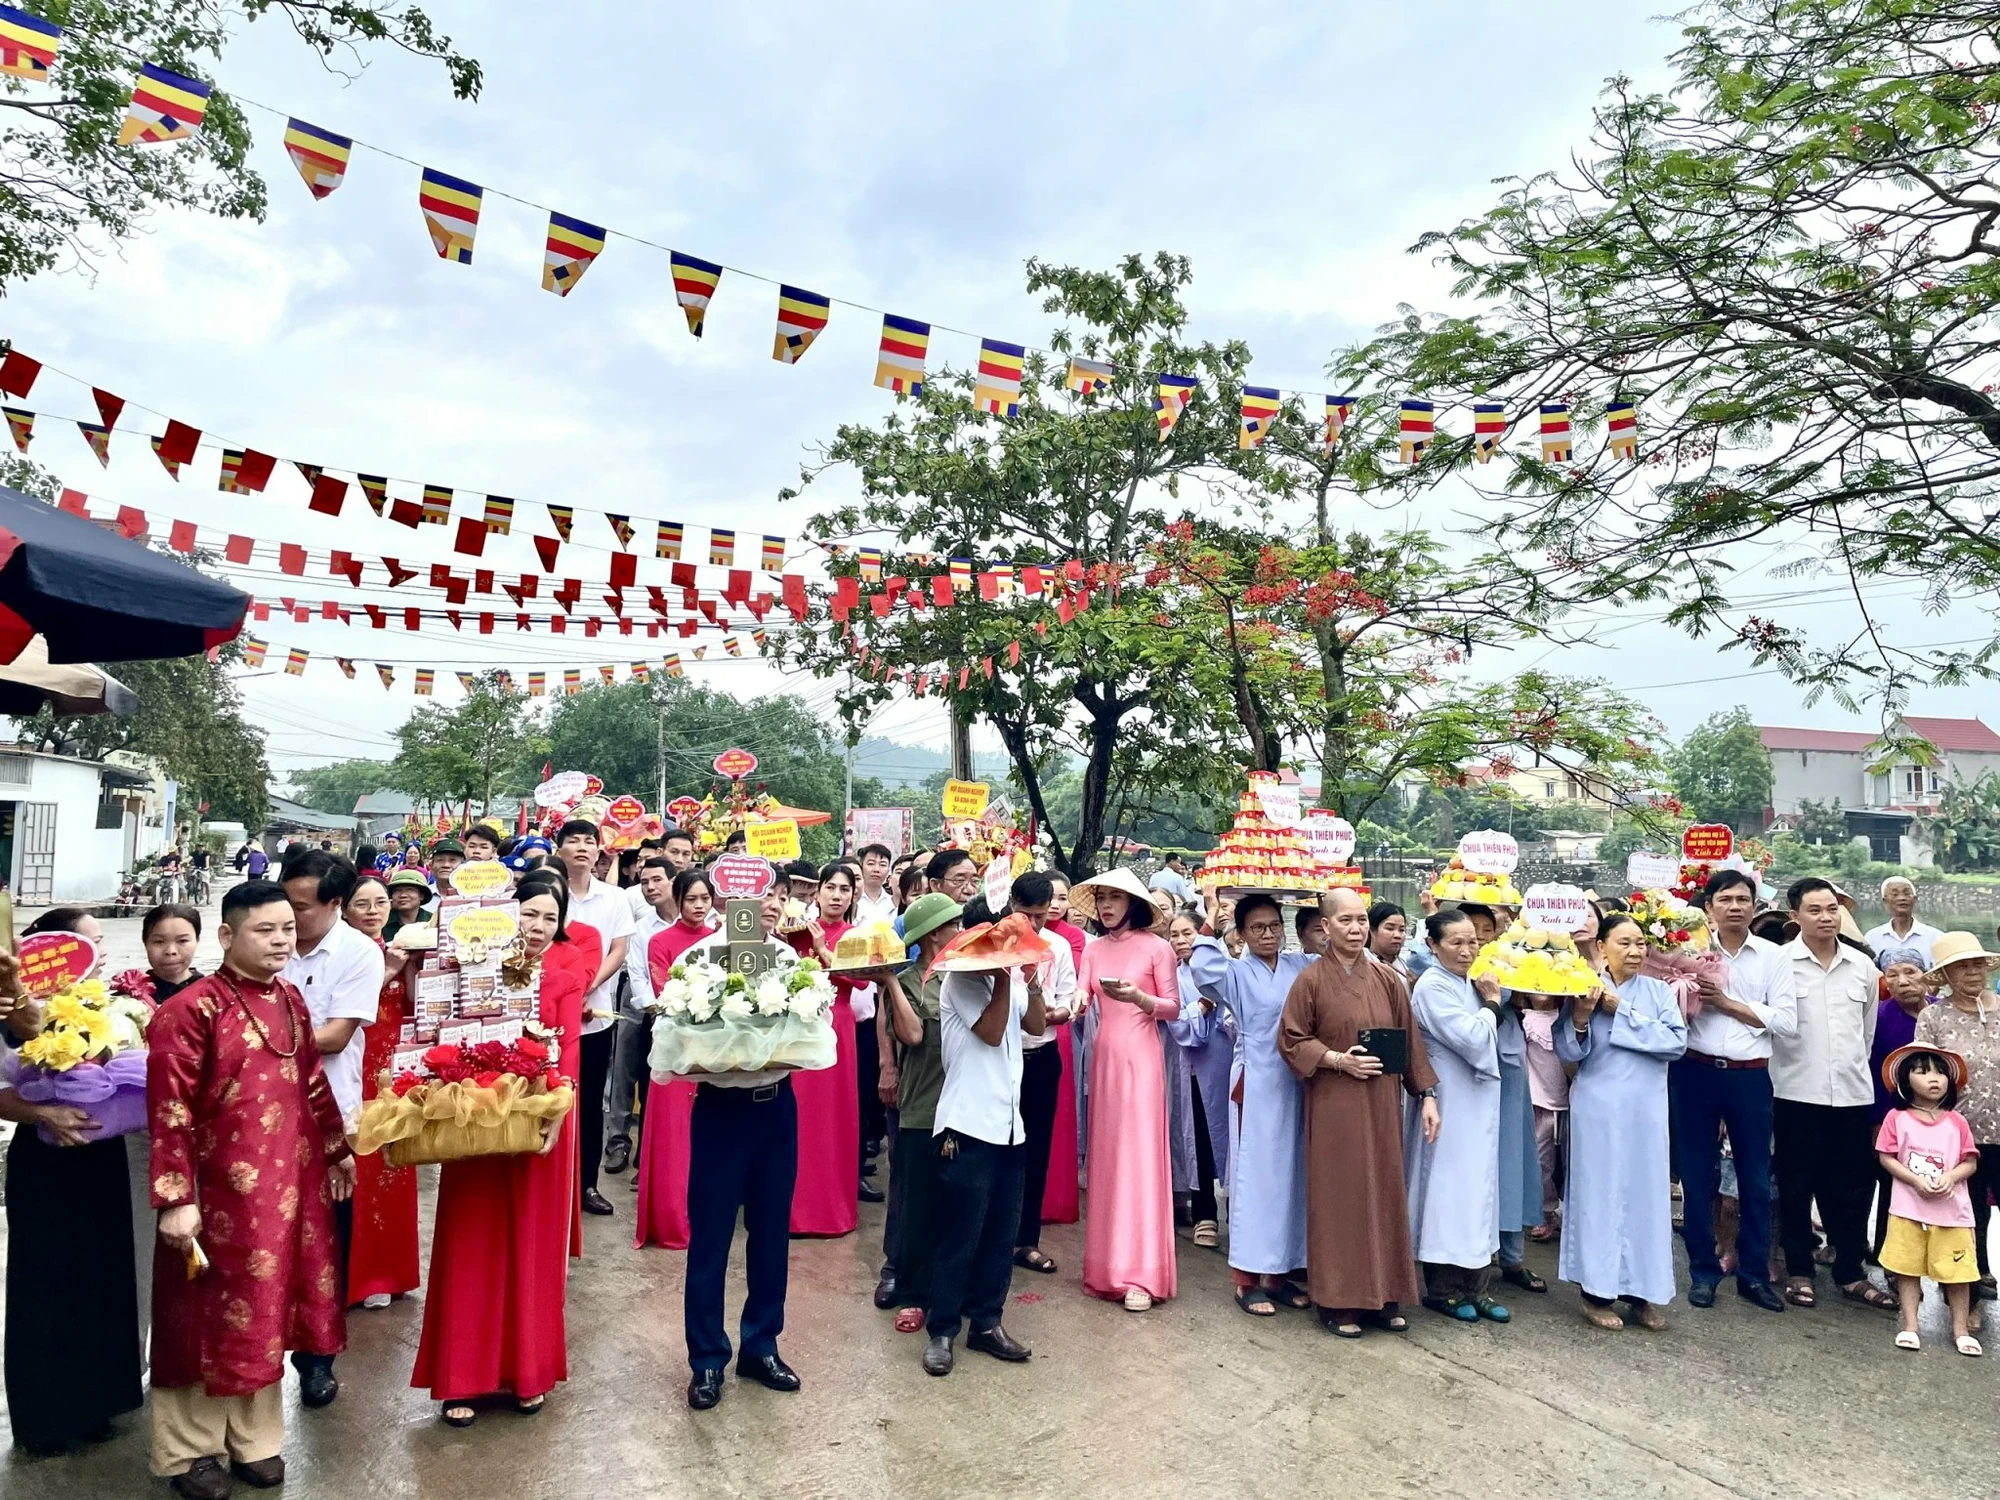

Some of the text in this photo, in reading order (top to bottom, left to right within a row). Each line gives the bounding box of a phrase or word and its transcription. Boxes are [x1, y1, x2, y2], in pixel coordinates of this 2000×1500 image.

[964, 827, 973, 842] AFC
[1336, 827, 1352, 841] PHÚC
[1463, 842, 1481, 854] CHÙA
[1693, 848, 1711, 856] Kính
[1526, 897, 1545, 909] CHÙA
[1568, 896, 1586, 910] PHÚC
